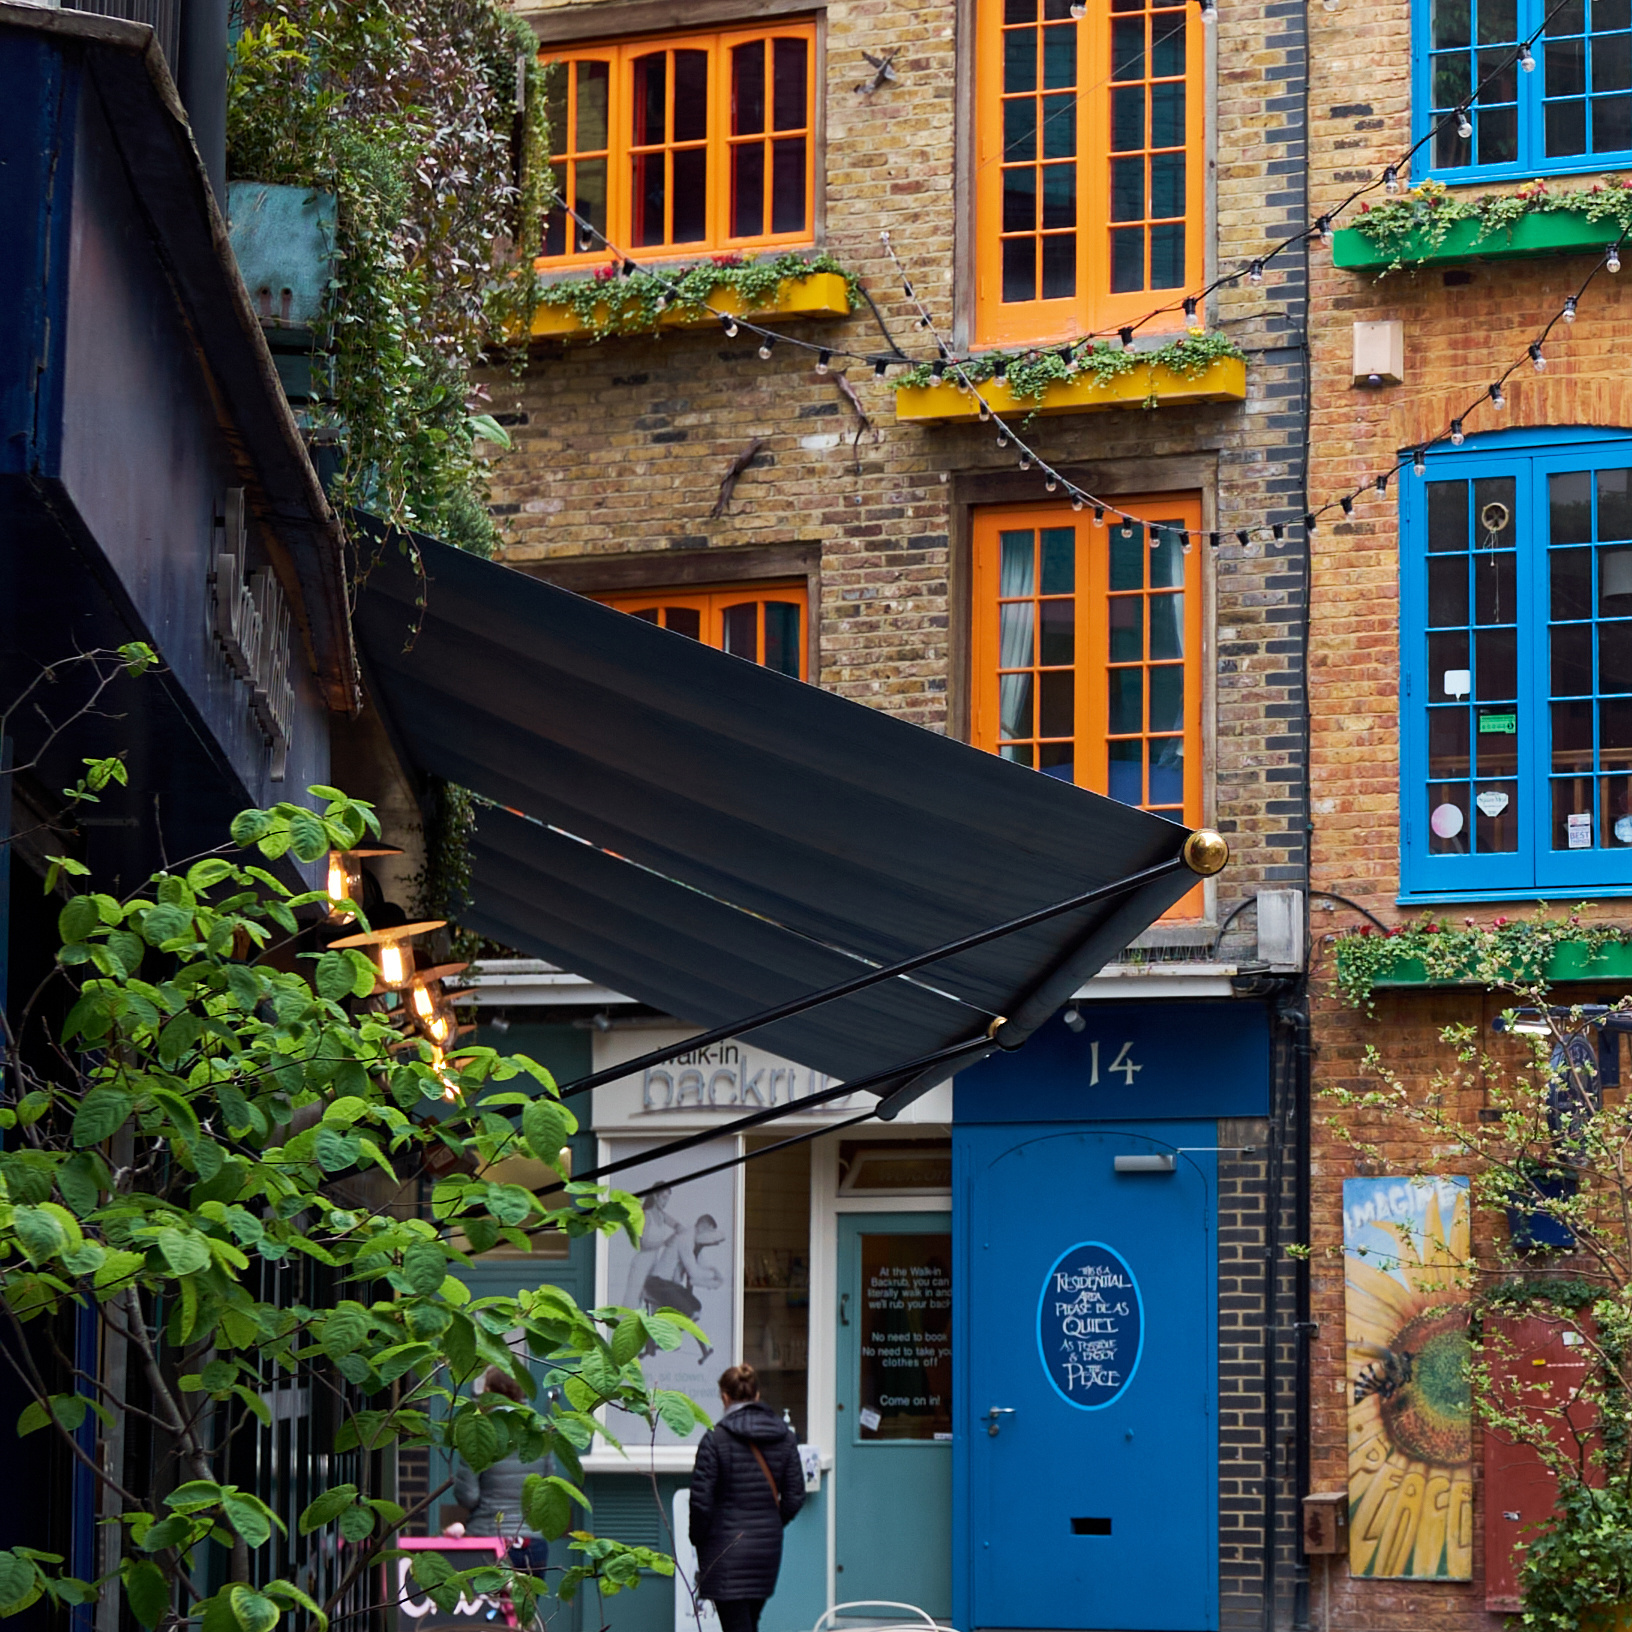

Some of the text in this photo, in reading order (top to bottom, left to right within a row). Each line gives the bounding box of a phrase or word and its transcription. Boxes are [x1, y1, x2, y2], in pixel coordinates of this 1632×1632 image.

[1086, 1040, 1142, 1087] 14
[880, 1266, 889, 1276] At
[892, 1266, 907, 1276] the
[913, 1279, 929, 1288] you
[932, 1278, 949, 1286] can
[1053, 1272, 1133, 1293] RESIDENTIAL
[902, 1288, 922, 1297] walk
[925, 1288, 933, 1297] in
[889, 1299, 904, 1309] rub
[907, 1300, 927, 1311] your
[1055, 1302, 1092, 1317] PLEASE
[1112, 1301, 1129, 1316] AS
[1063, 1316, 1119, 1339] QUIET
[872, 1332, 885, 1342] No
[887, 1332, 910, 1342] need
[913, 1332, 922, 1342] to
[862, 1346, 875, 1356] No
[878, 1346, 900, 1356] need
[904, 1346, 913, 1356] to
[915, 1346, 935, 1356] take
[882, 1357, 938, 1367] clothes off
[1062, 1363, 1121, 1390] PEACE
[880, 1394, 941, 1406] Come on in!
[1349, 1437, 1472, 1576] PEACE
